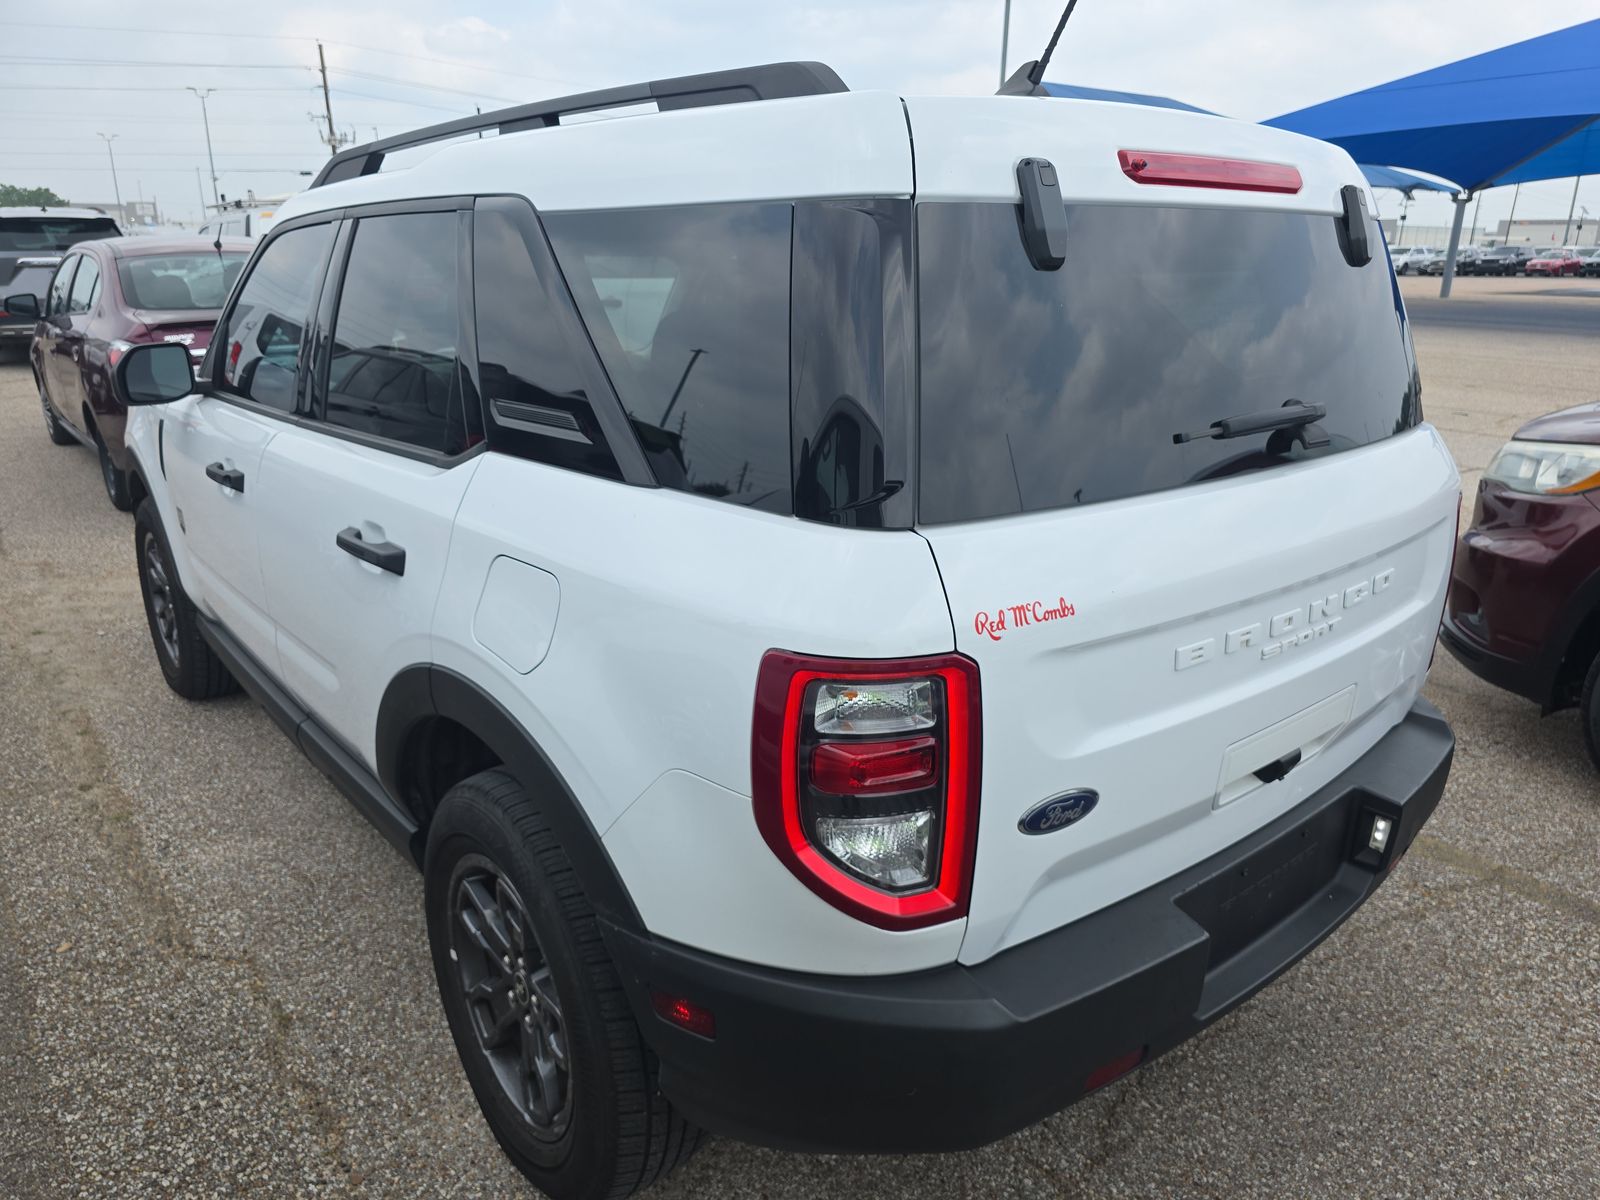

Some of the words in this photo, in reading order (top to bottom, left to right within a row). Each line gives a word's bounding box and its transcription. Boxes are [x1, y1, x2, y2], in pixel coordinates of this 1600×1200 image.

[975, 609, 1006, 641] Red
[1007, 597, 1075, 627] McCombs
[1174, 567, 1395, 672] BRONCO
[1260, 616, 1342, 660] SPORT
[1040, 799, 1085, 829] Ford
